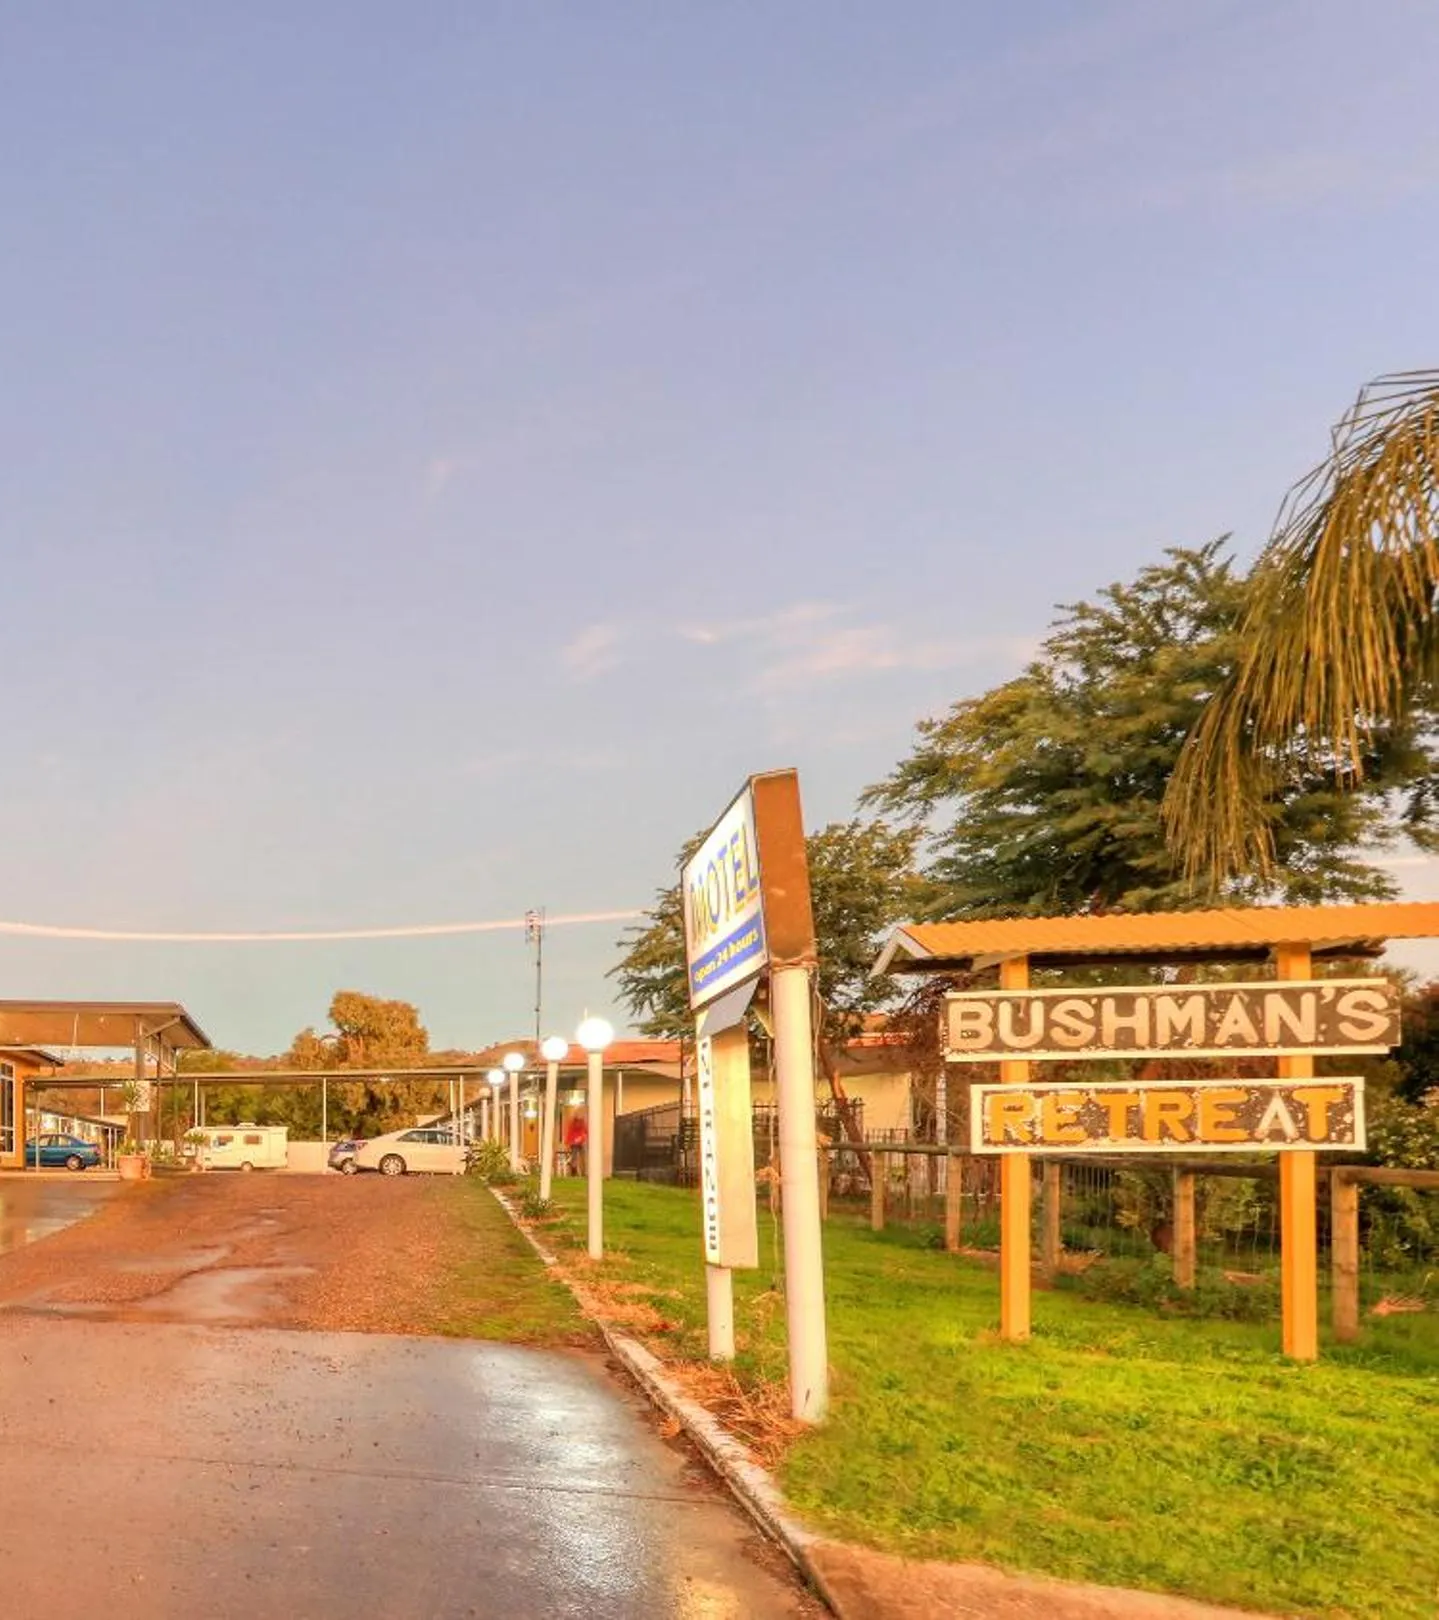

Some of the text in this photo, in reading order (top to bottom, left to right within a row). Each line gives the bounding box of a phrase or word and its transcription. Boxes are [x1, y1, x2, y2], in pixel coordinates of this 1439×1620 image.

[691, 822, 759, 947] MOTEL
[694, 927, 759, 984] open 24 hours
[946, 987, 1390, 1049] BUSHMAN'S
[986, 1086, 1344, 1143] RETREAT
[701, 1041, 718, 1251] NTRANCE
